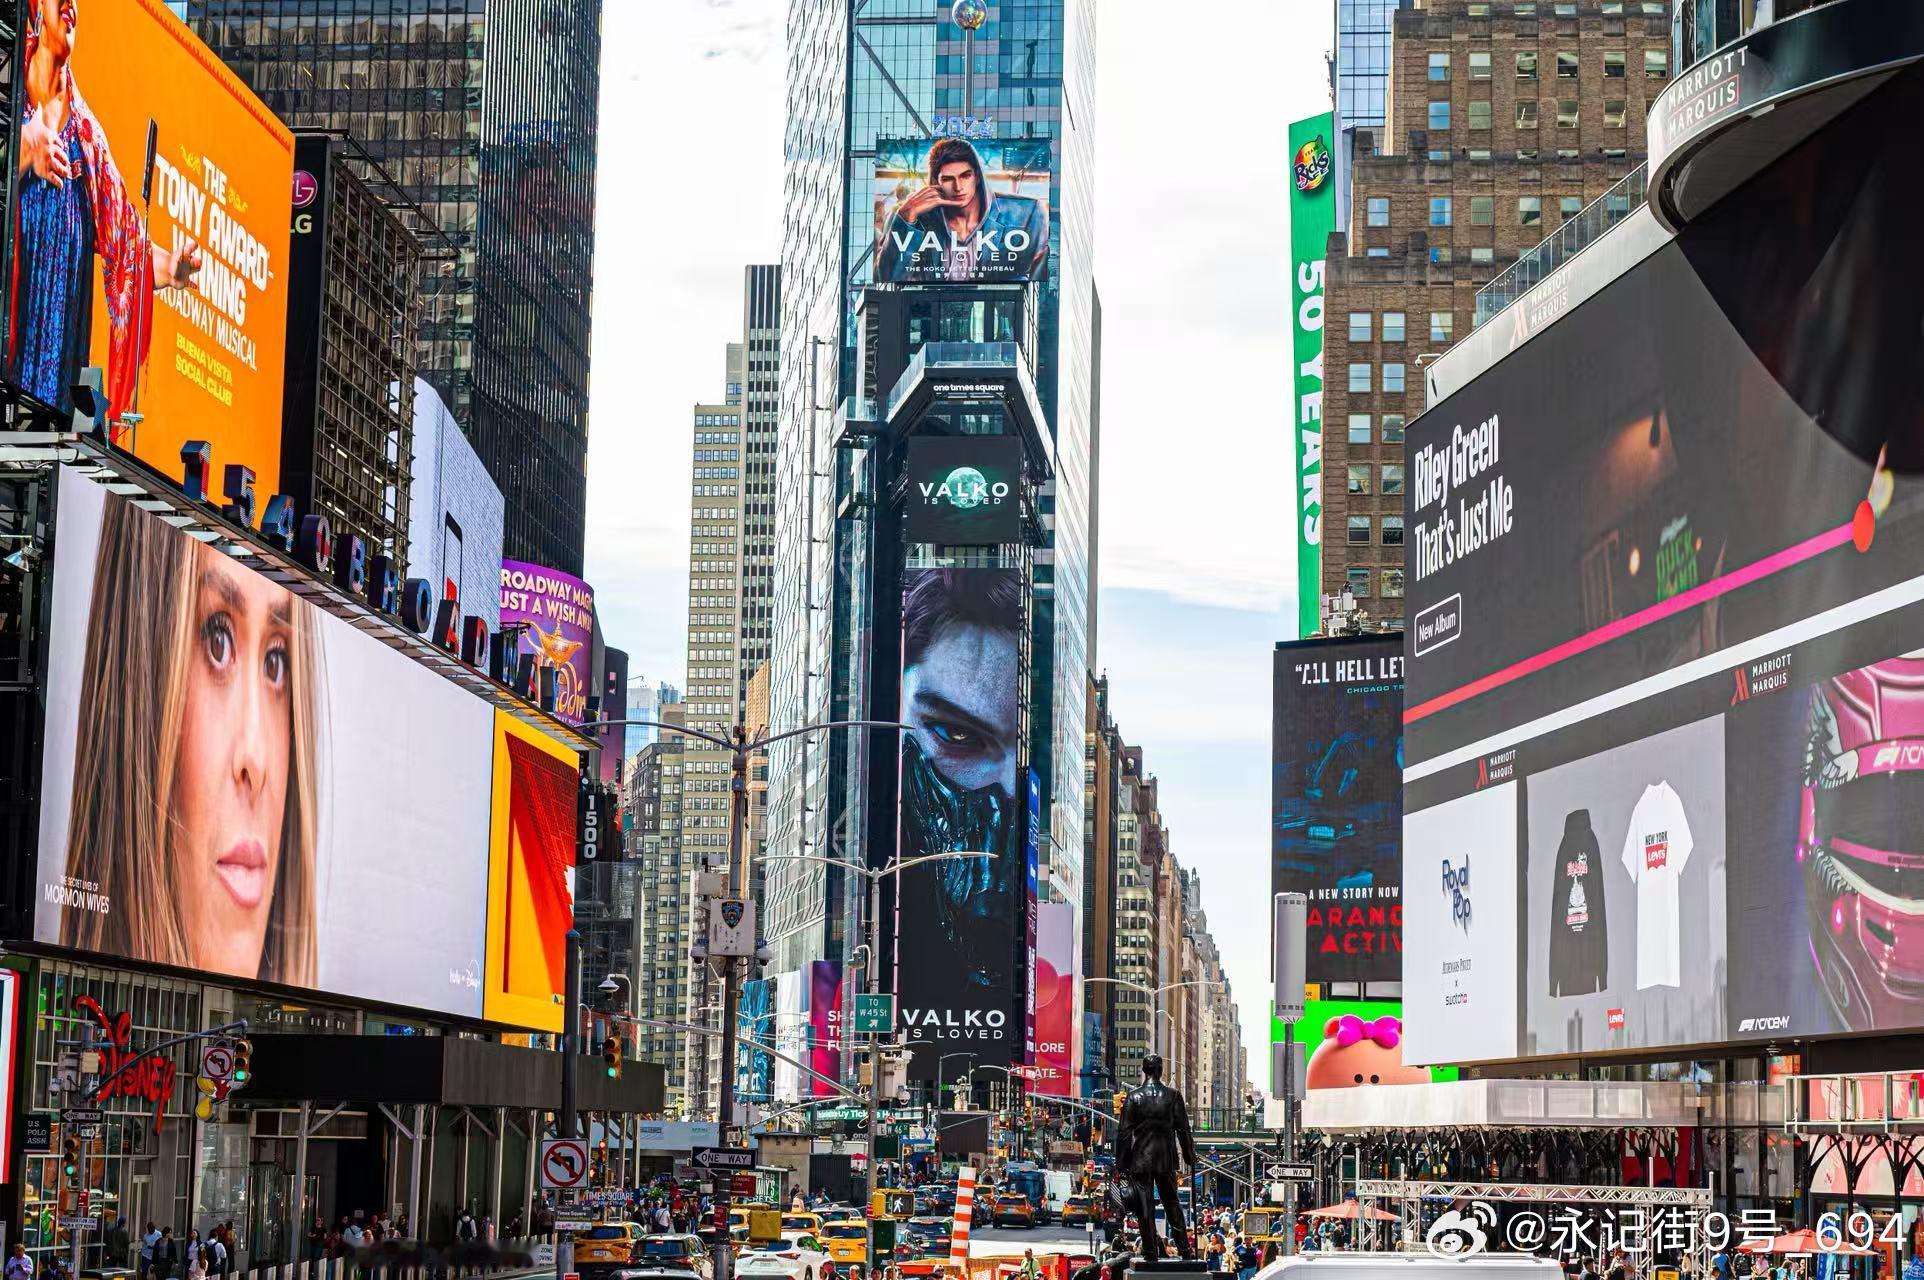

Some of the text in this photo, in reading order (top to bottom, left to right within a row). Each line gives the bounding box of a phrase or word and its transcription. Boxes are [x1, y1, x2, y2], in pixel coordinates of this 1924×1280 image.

[1668, 45, 1748, 112] MARRIOTT
[1669, 81, 1736, 139] MARQUIS
[202, 156, 227, 206] THE
[155, 152, 206, 238] TONY
[892, 229, 1030, 252] VALKO
[900, 252, 1018, 262] IS LOVED
[1531, 291, 1568, 328] MARQUIS
[215, 314, 258, 372] MUSICAL
[176, 333, 233, 386] BUENA VISTA
[175, 354, 233, 408] SOCIAL CLUB
[975, 384, 1005, 393] square
[1415, 413, 1499, 513] Riley Green
[919, 482, 1009, 498] VALKO
[924, 497, 1001, 505] IS LOVED
[1415, 475, 1513, 582] That's Just Me
[500, 568, 572, 600] ROADWAY
[500, 590, 529, 612] UST
[532, 600, 542, 615] A
[546, 598, 575, 624] WISH
[1419, 612, 1456, 643] New Album
[1336, 659, 1374, 682] HELL
[1752, 653, 1791, 677] MARRIOTT
[1346, 685, 1390, 694] CHICAGO
[1752, 672, 1787, 694] MARQUIS
[1490, 750, 1516, 767] MARRIOTT
[1490, 765, 1513, 780] MARQUIS
[583, 795, 597, 859] 1500
[1645, 831, 1668, 846] NEW YORK
[1442, 854, 1469, 894] Royal
[44, 883, 110, 915] MORMON WIVES
[1308, 886, 1400, 900] A NEW STORY NOW
[859, 1008, 887, 1017] W 45 St
[868, 999, 878, 1007] TO
[902, 1008, 1006, 1028] VALKO
[1754, 1016, 1790, 1031] ACADEMY
[937, 1029, 1003, 1039] LOVED
[1035, 1043, 1065, 1053] LORE
[1034, 1068, 1062, 1078] ATE.
[84, 1112, 98, 1120] WAY
[27, 1129, 47, 1137] POLO
[701, 1153, 748, 1164] ONE WAY
[585, 1190, 634, 1201] TIMES SQUARE
